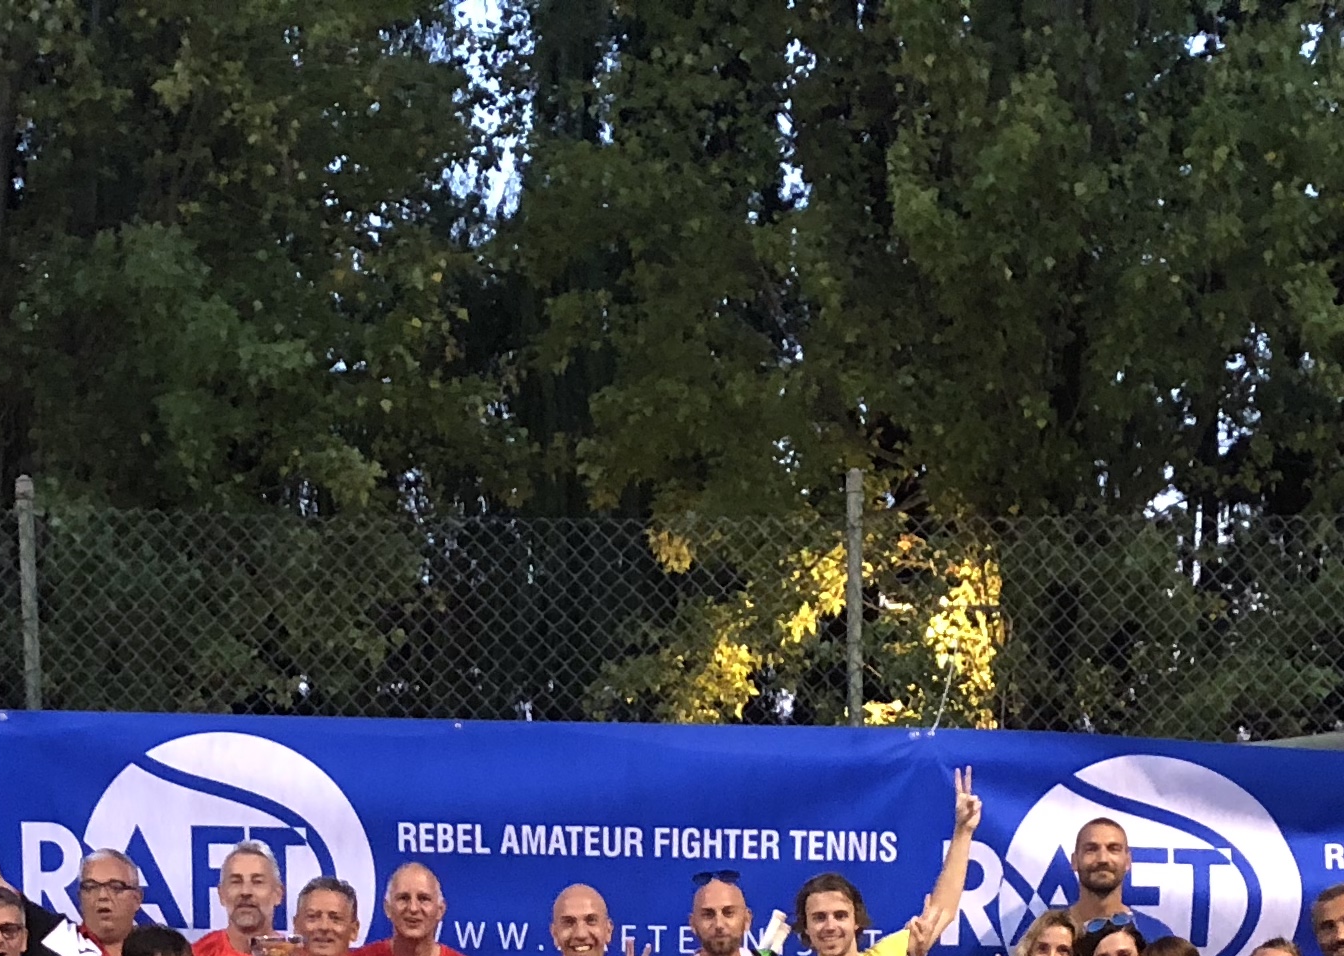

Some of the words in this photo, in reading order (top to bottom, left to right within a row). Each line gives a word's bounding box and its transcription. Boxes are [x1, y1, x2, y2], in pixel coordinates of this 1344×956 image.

[397, 822, 491, 854] REBEL
[500, 825, 644, 858] AMATEUR
[654, 828, 780, 861] FIGHTER
[789, 831, 898, 863] TENNIS
